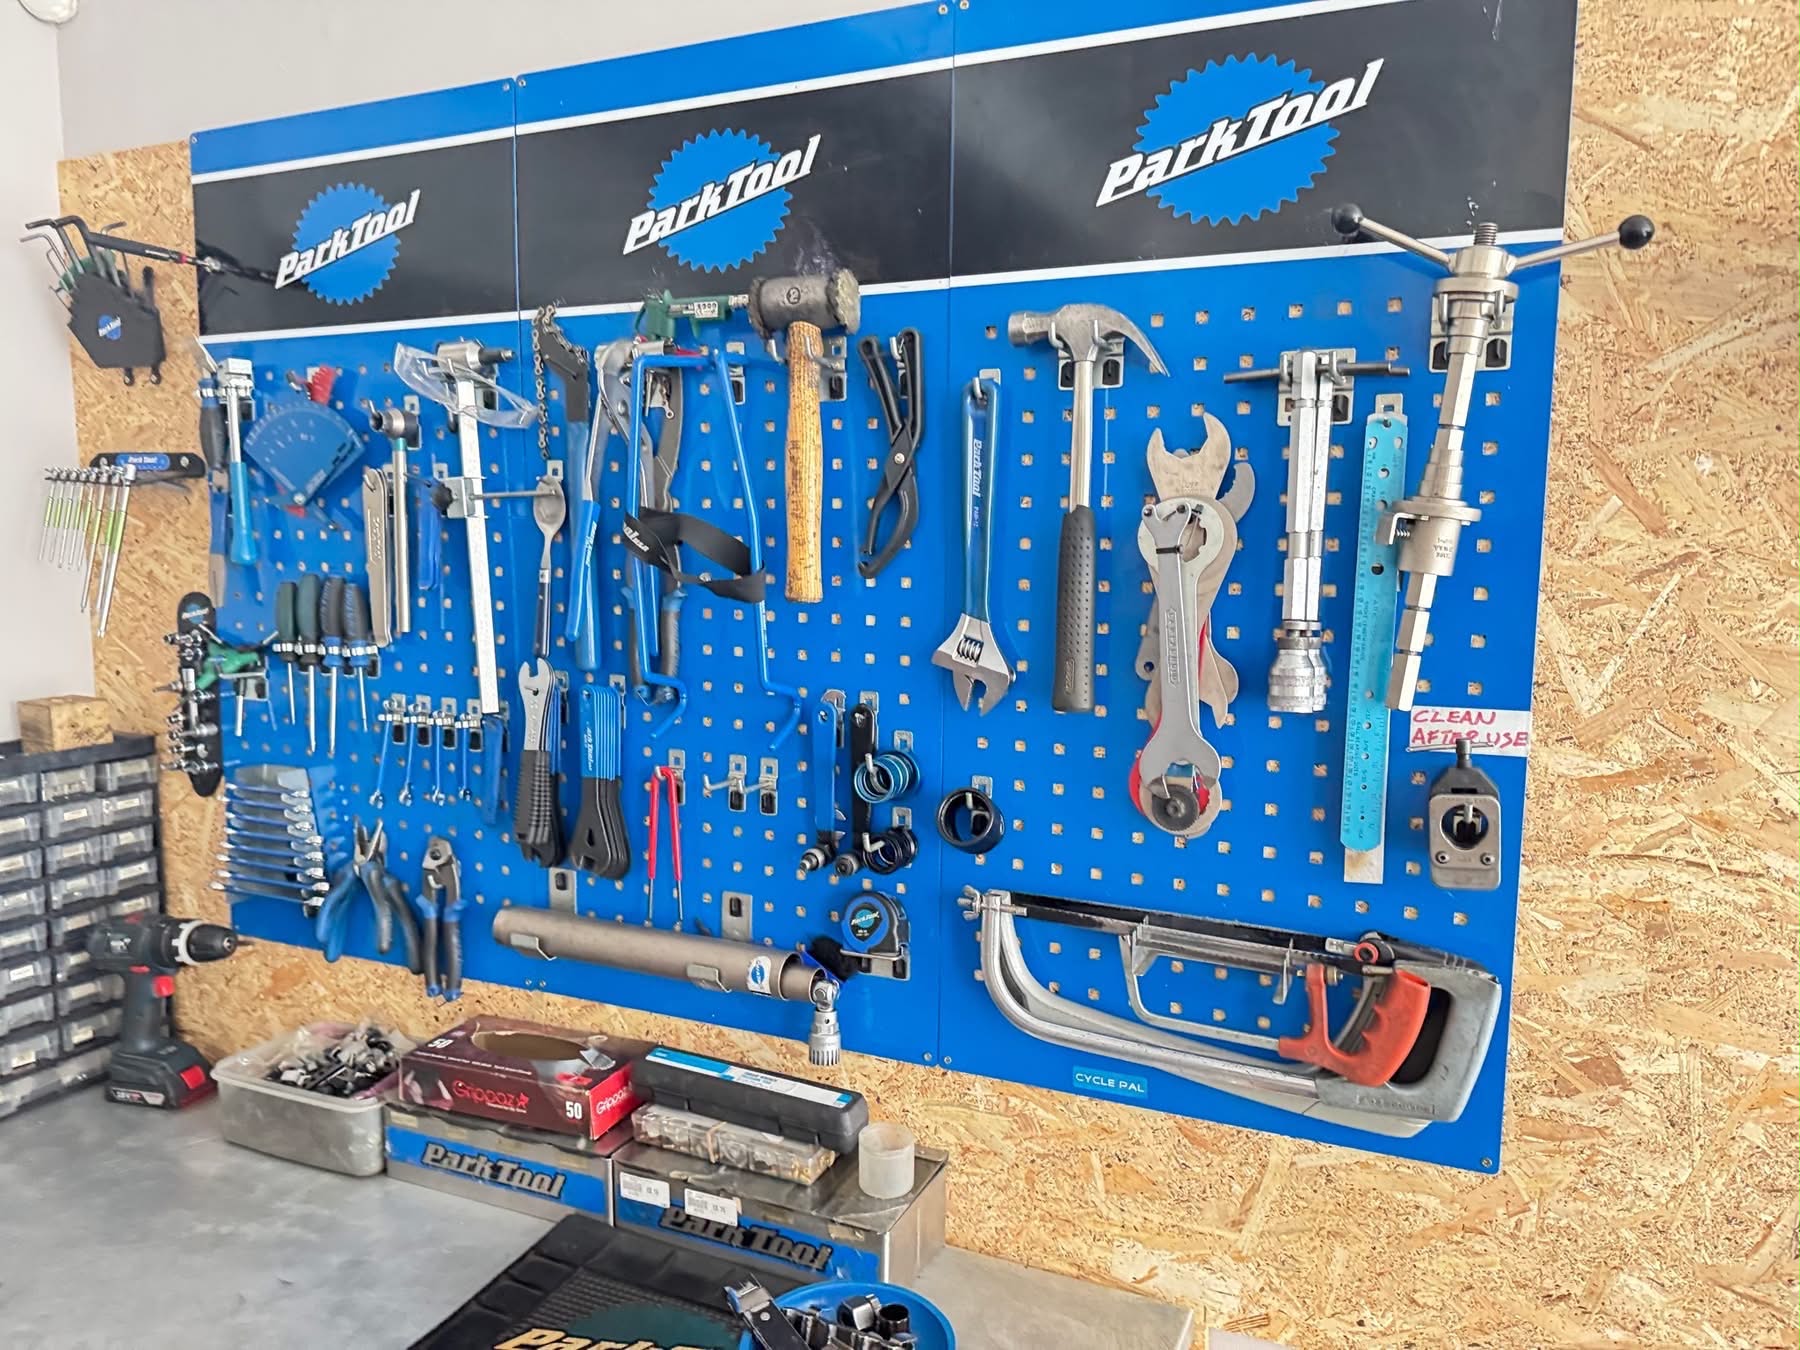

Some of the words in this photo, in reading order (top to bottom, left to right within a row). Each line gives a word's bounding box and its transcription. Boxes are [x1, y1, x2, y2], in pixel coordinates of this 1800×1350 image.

[1412, 709, 1497, 725] CLEAN
[1411, 727, 1480, 745] AFTER
[1486, 731, 1529, 749] USE
[1075, 1073, 1115, 1088] CYCLE
[1119, 1080, 1145, 1093] PAL
[566, 1101, 583, 1120] 50
